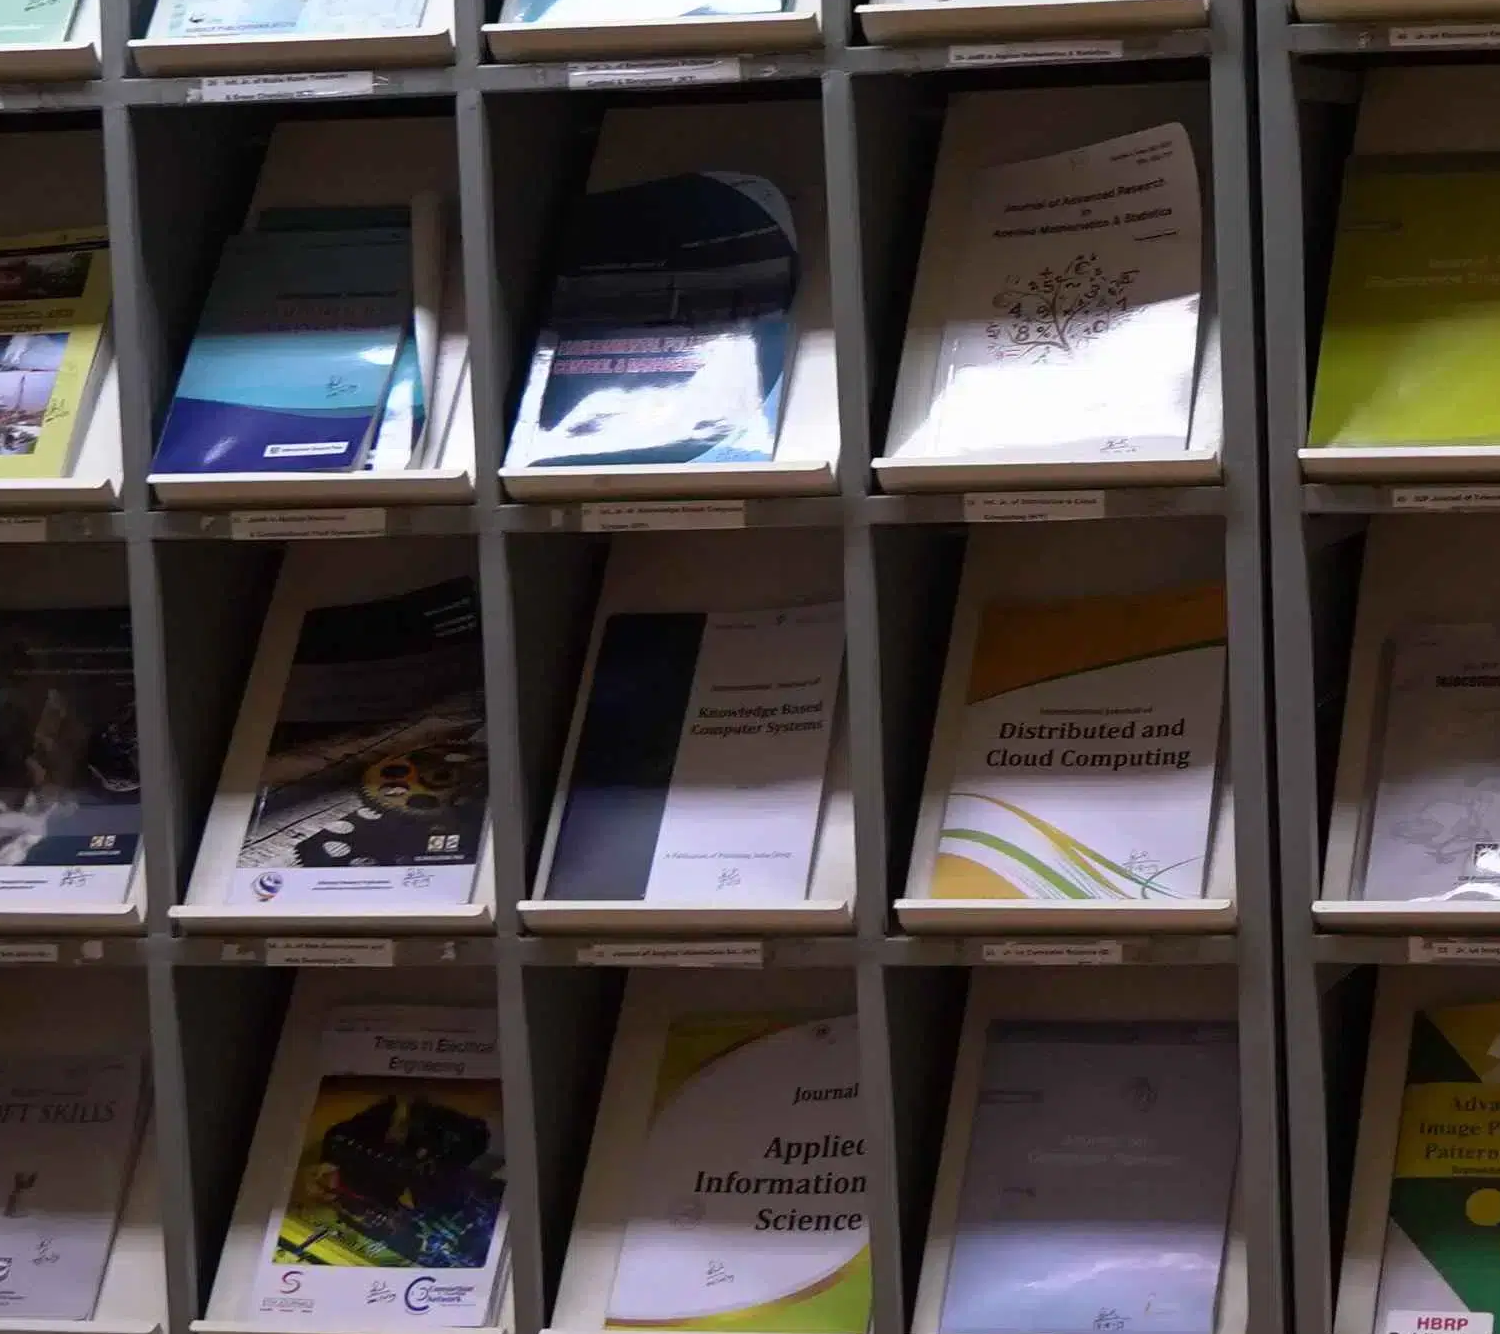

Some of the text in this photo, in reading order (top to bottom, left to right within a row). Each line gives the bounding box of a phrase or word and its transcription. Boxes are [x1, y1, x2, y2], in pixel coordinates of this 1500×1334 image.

[998, 717, 1185, 741] Distributed and
[985, 748, 1192, 772] Cloud Computing
[791, 1081, 860, 1106] Journal
[36, 1099, 117, 1125] SKILLS
[693, 1169, 867, 1195] Information
[754, 1206, 864, 1232] Science
[1415, 1316, 1470, 1331] HBRP
